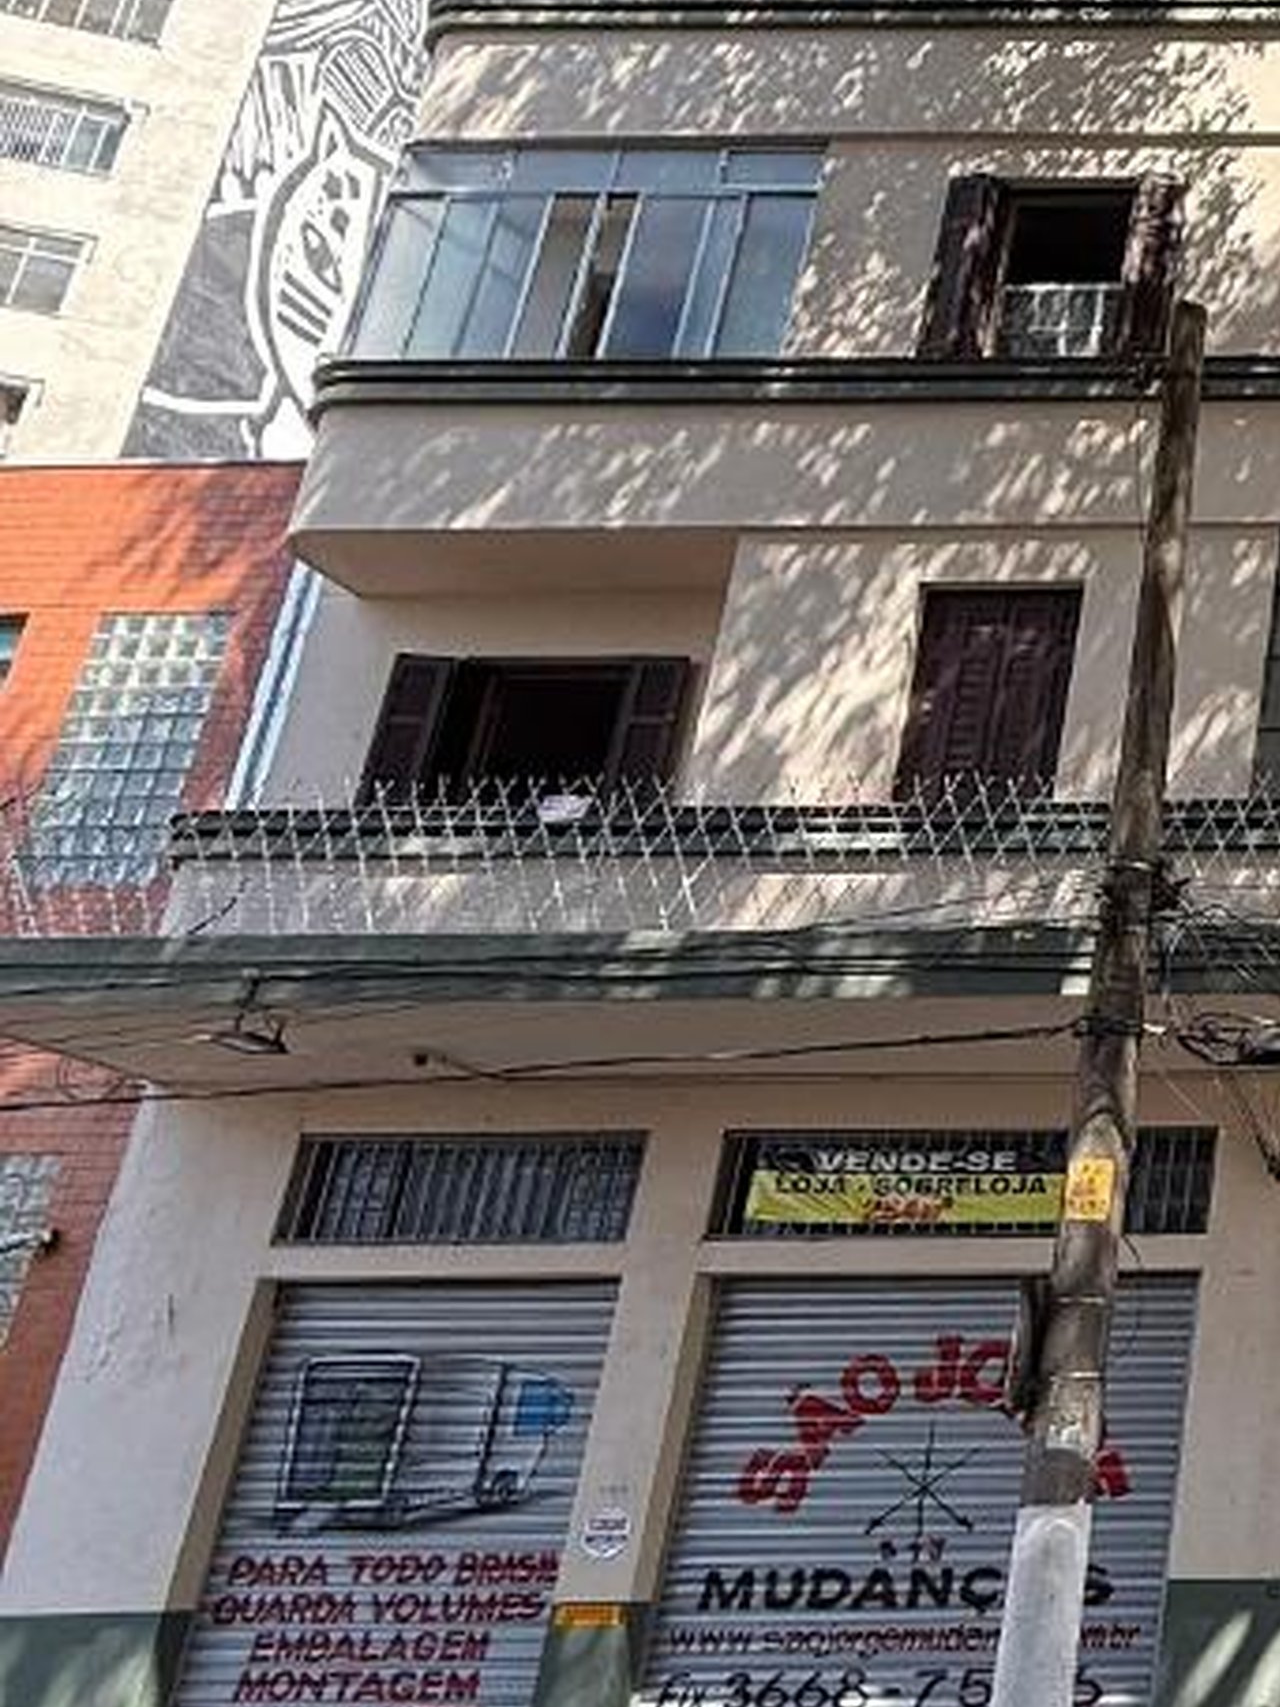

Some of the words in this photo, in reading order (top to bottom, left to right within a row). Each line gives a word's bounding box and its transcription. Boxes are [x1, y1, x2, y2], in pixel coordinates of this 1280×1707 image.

[816, 1150, 1018, 1173] VENDE-SE
[775, 1176, 846, 1195] LOJA
[227, 1555, 328, 1585] PARA
[350, 1554, 447, 1584] TODO
[699, 1564, 1115, 1613] MUDANÇS
[370, 1597, 545, 1624] VOLUMES
[248, 1631, 491, 1662] EMBALAGEM
[231, 1669, 481, 1702] MONTAGEM
